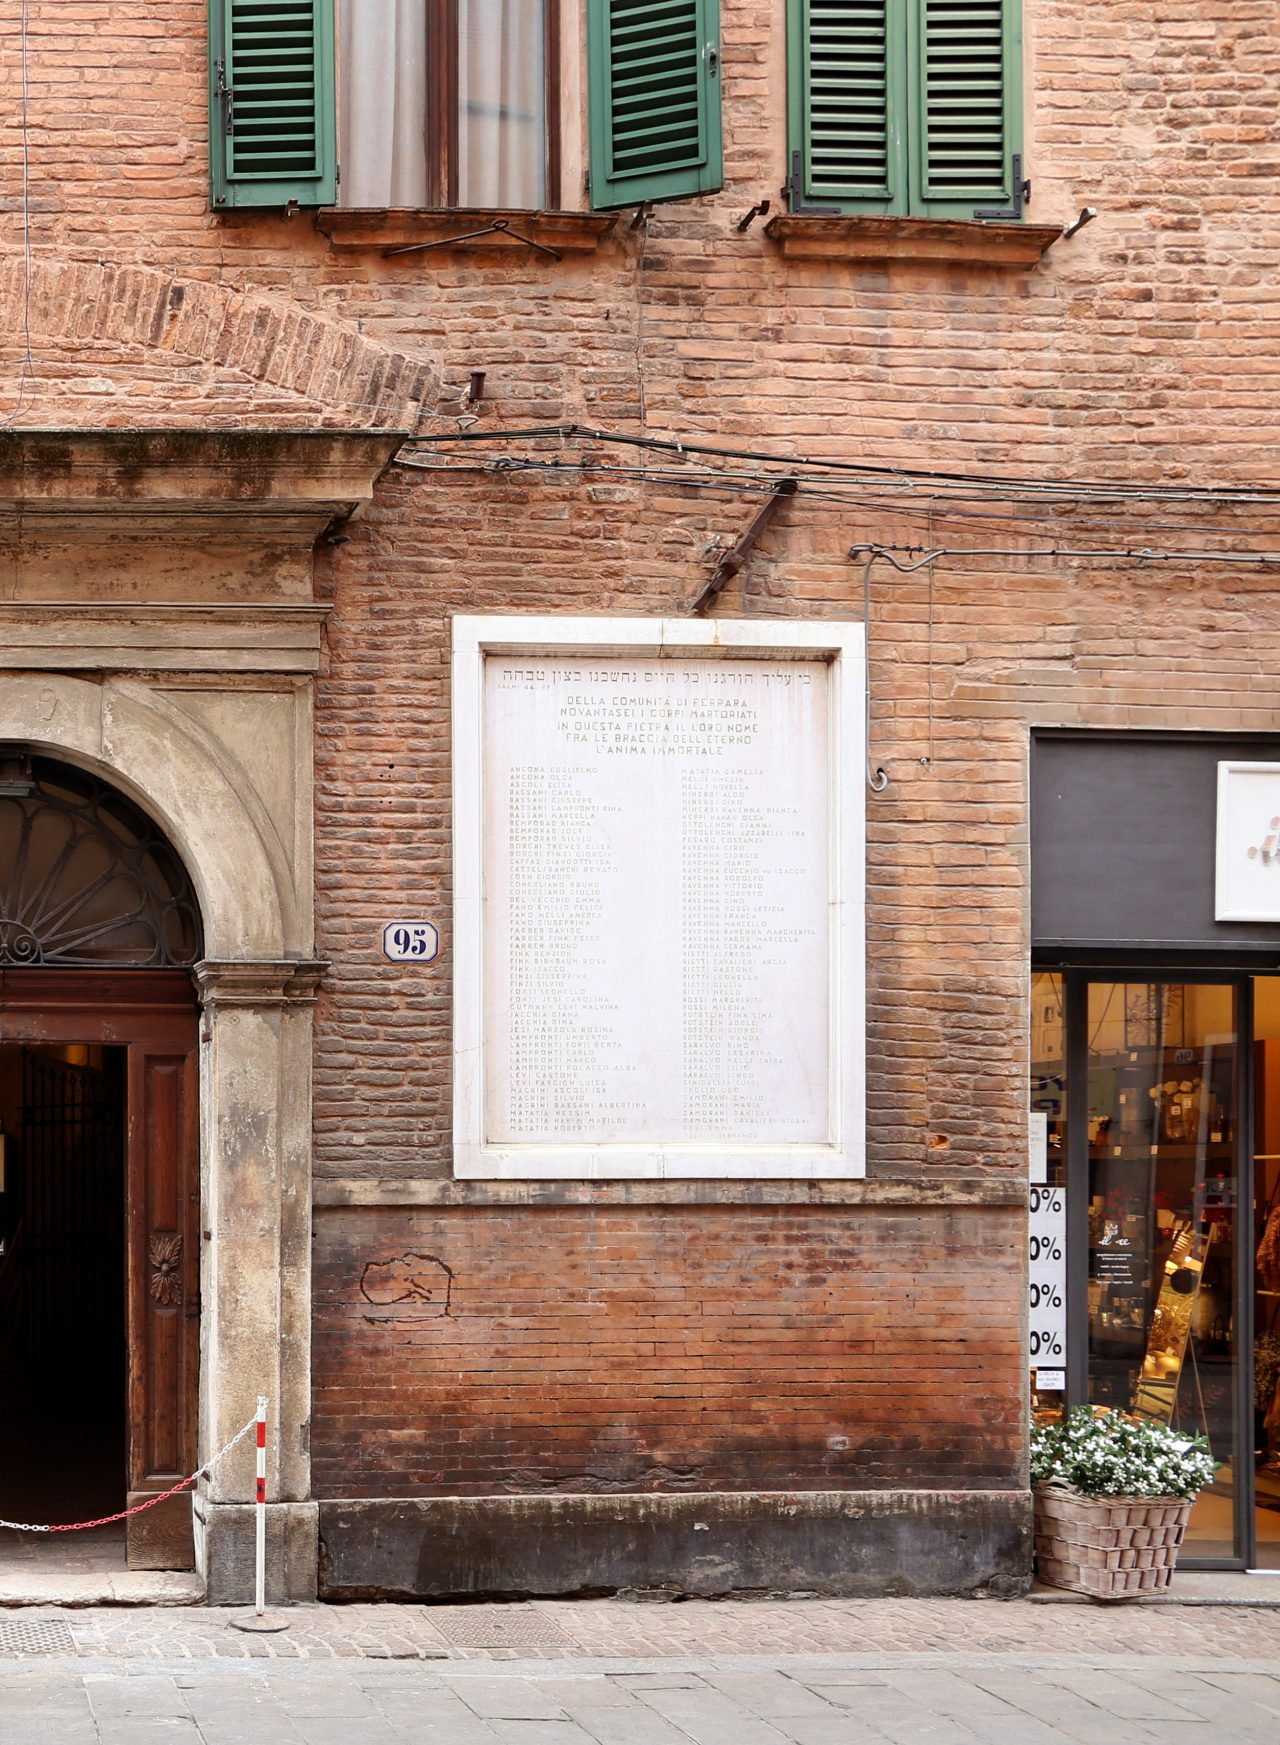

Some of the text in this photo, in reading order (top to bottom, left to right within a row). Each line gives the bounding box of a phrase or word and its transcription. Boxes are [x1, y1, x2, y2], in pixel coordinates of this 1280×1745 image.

[567, 695, 605, 705] DELLA
[676, 697, 687, 707] DI
[692, 697, 747, 708] FERRARA
[560, 707, 634, 717] NOVANTASEI
[650, 708, 684, 718] CORPI
[689, 709, 756, 719] MARTORIATI
[557, 721, 568, 731] IN
[626, 721, 671, 732] PIETRA
[676, 722, 686, 732] IL
[691, 722, 722, 732] LORO
[727, 723, 758, 733] NOME
[565, 733, 588, 744] FRA
[594, 733, 608, 742] LE
[614, 733, 667, 743] BRACCIA
[652, 745, 723, 756] IMMORTALE
[393, 928, 426, 955] 95
